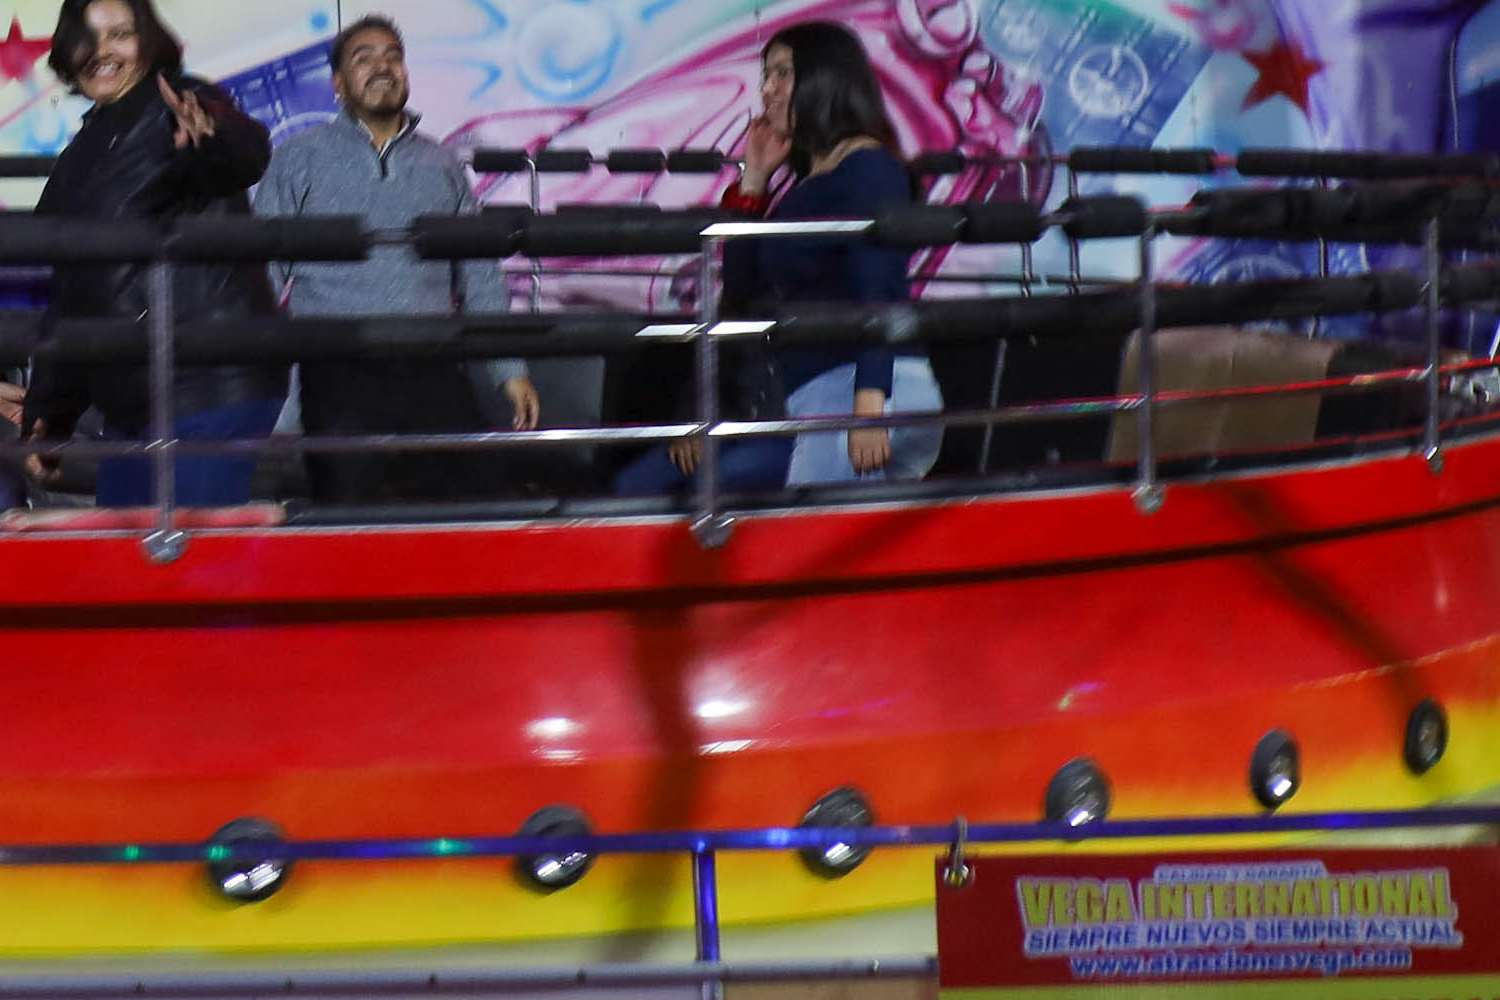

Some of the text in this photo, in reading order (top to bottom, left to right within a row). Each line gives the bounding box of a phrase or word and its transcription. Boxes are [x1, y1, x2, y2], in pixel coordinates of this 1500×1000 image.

[1019, 871, 1453, 927] VEGA INTERNATIONAL
[1027, 918, 1459, 951] SIEMPRE NUEVOS SIEMPRE ACTUAL
